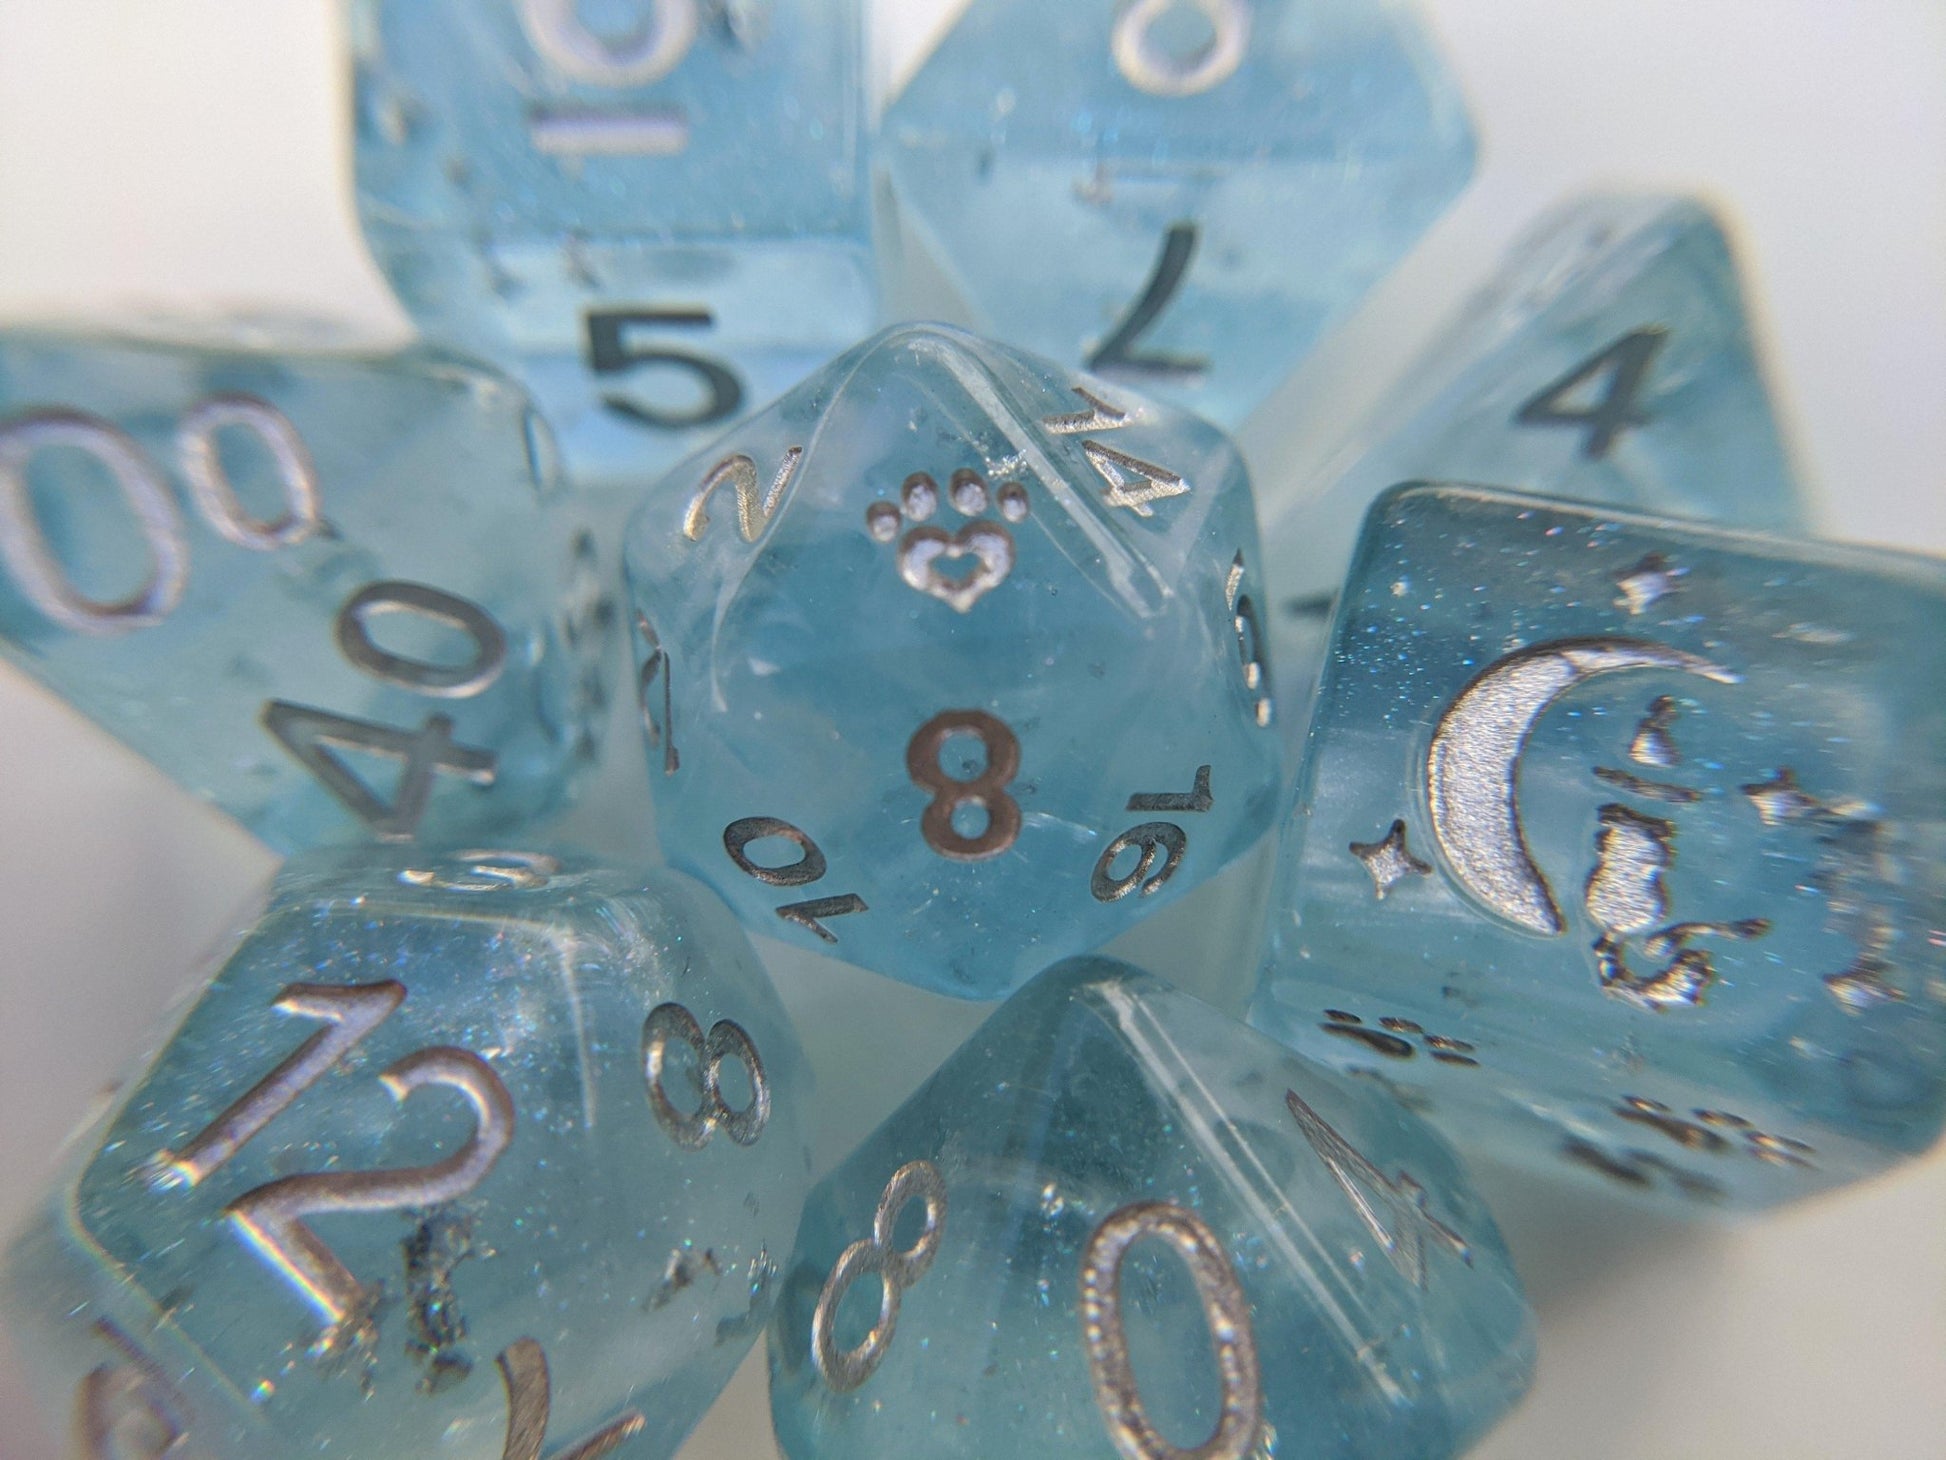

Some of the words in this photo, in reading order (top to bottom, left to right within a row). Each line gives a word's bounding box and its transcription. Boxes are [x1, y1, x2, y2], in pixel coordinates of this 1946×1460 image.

[583, 305, 746, 434] 5
[1083, 220, 1212, 384] 7
[1042, 386, 1191, 517] 14
[1516, 324, 1671, 460] 4
[259, 578, 506, 842] 40
[907, 709, 1021, 861] 8
[723, 816, 869, 943] 10
[160, 978, 515, 1327] 12
[643, 1002, 770, 1150] 8
[1286, 1087, 1474, 1293] 4
[812, 1160, 947, 1392] 8
[1080, 1200, 1266, 1460] 0
